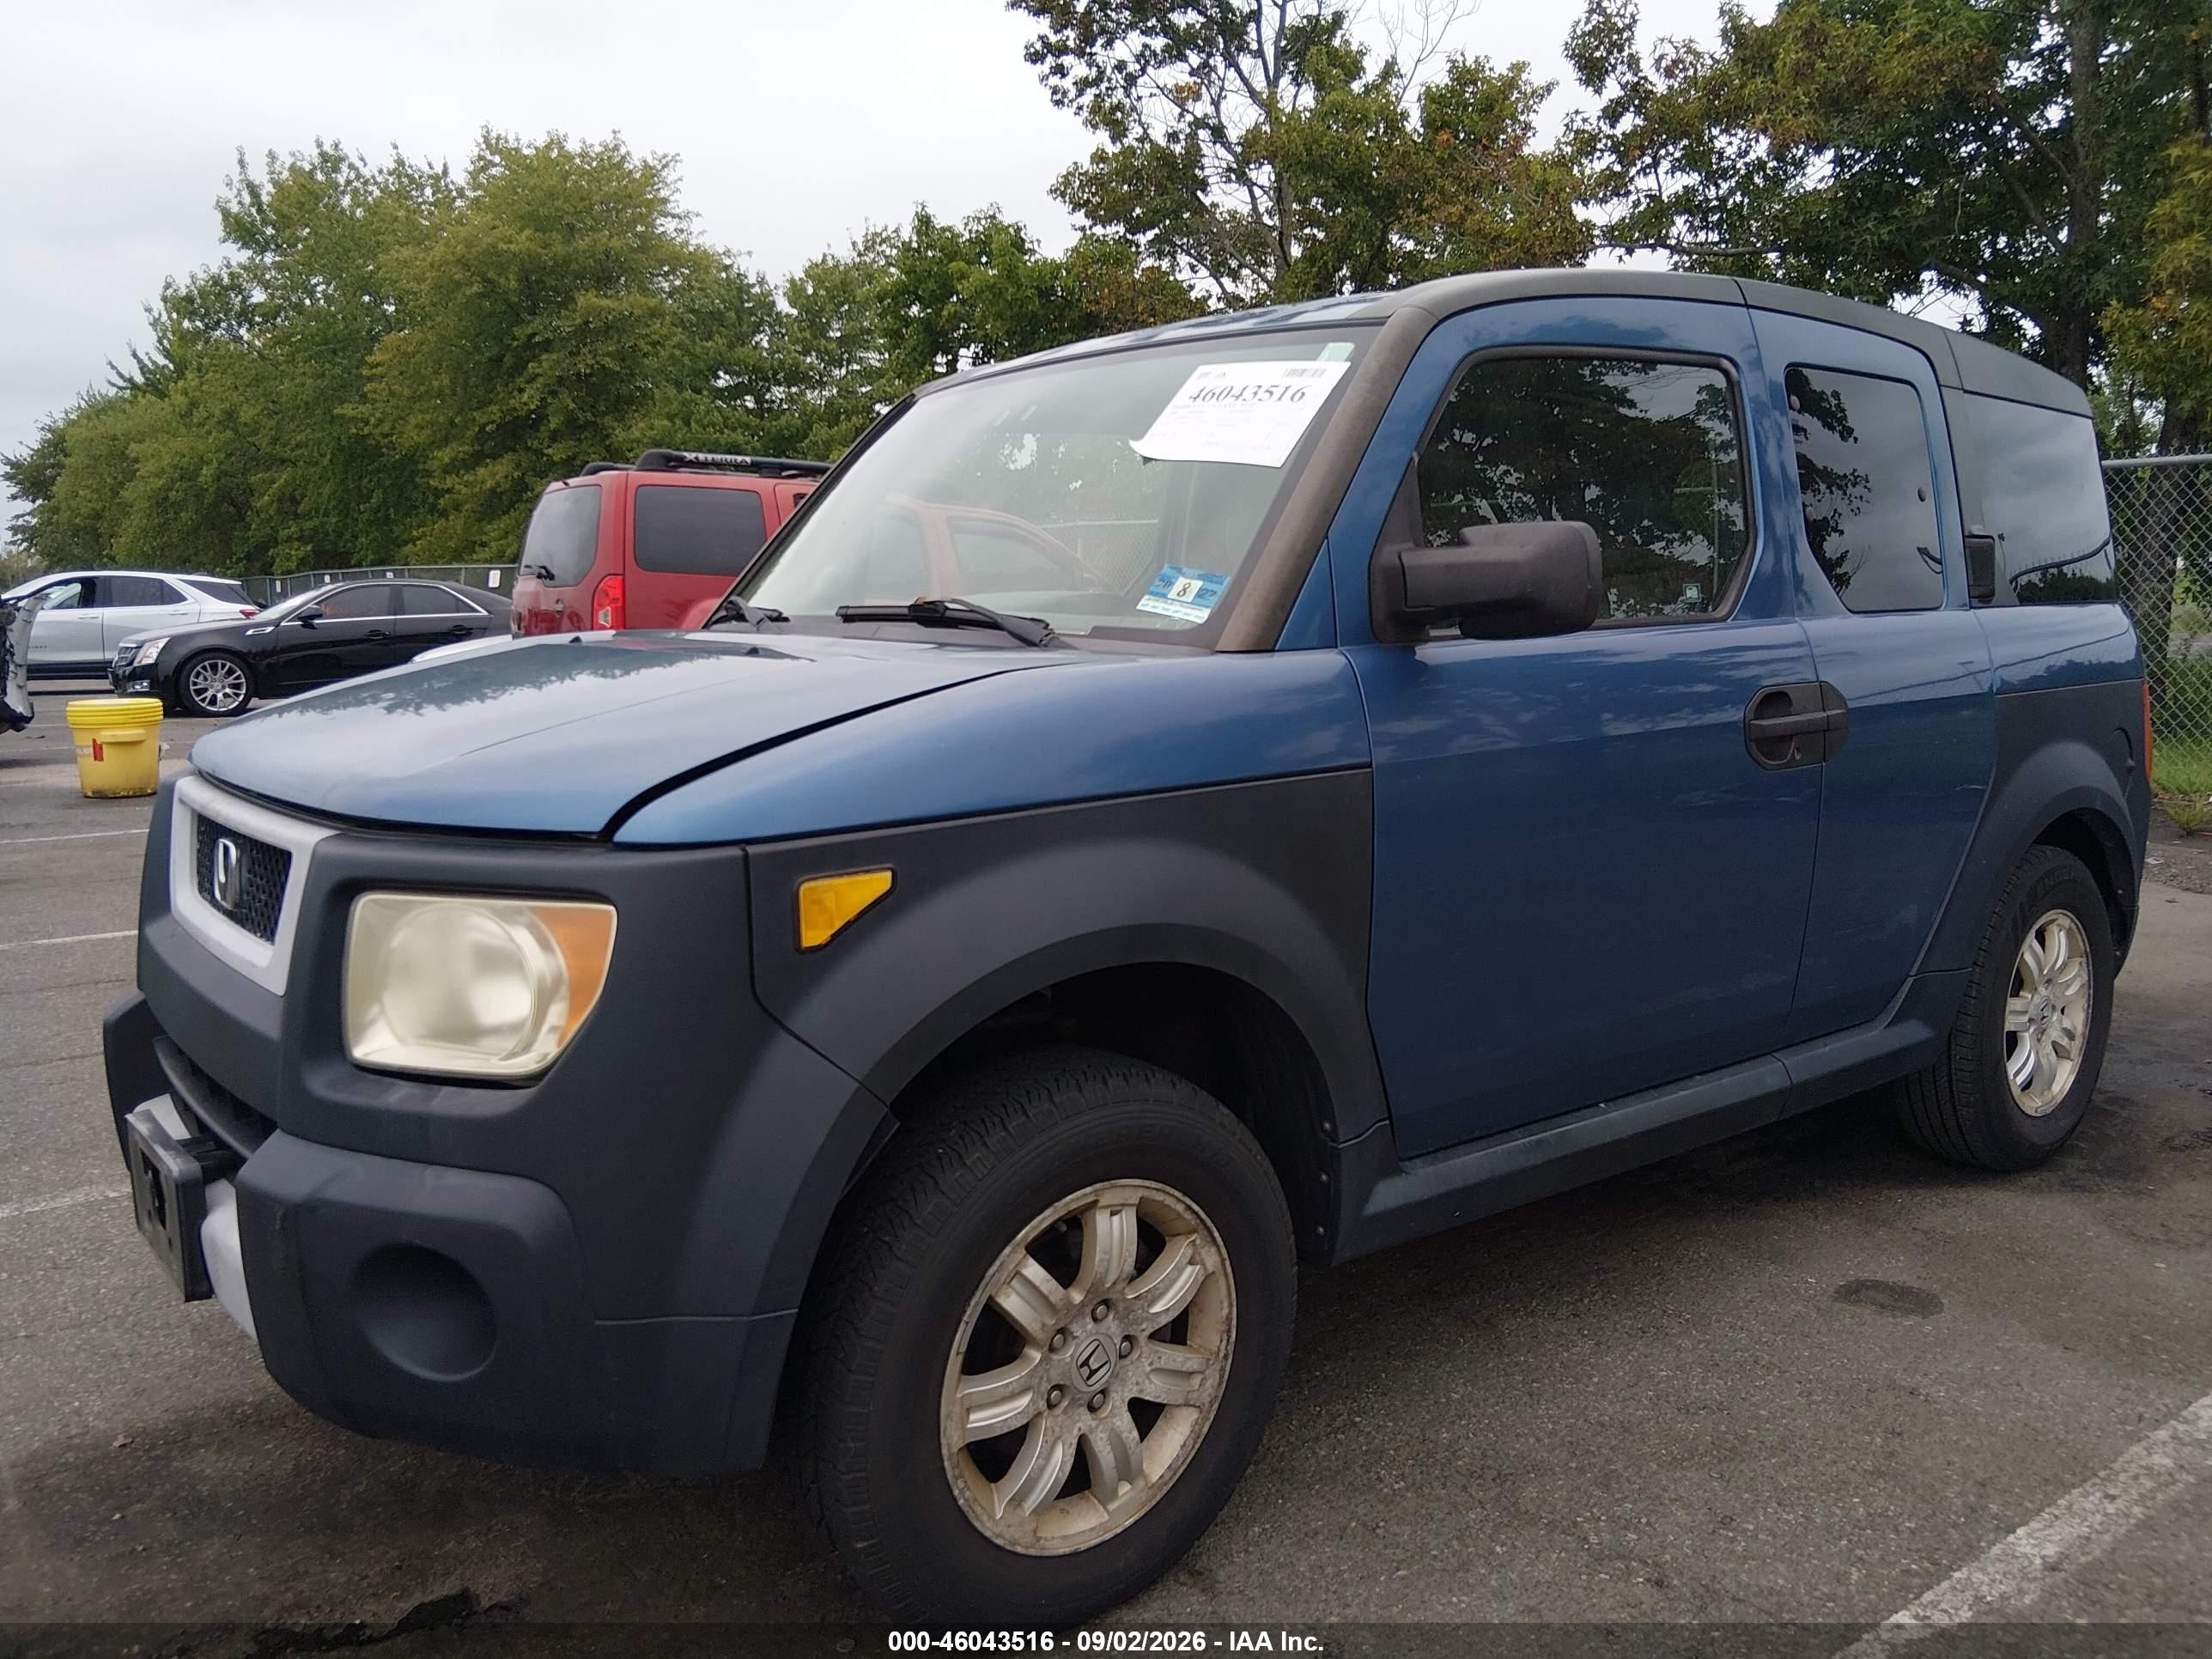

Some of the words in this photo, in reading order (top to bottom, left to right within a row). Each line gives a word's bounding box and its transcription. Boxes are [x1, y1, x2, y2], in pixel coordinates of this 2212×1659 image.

[1188, 385, 1311, 404] 46043516
[684, 453, 750, 465] XTERRA
[1176, 581, 1192, 598] 8
